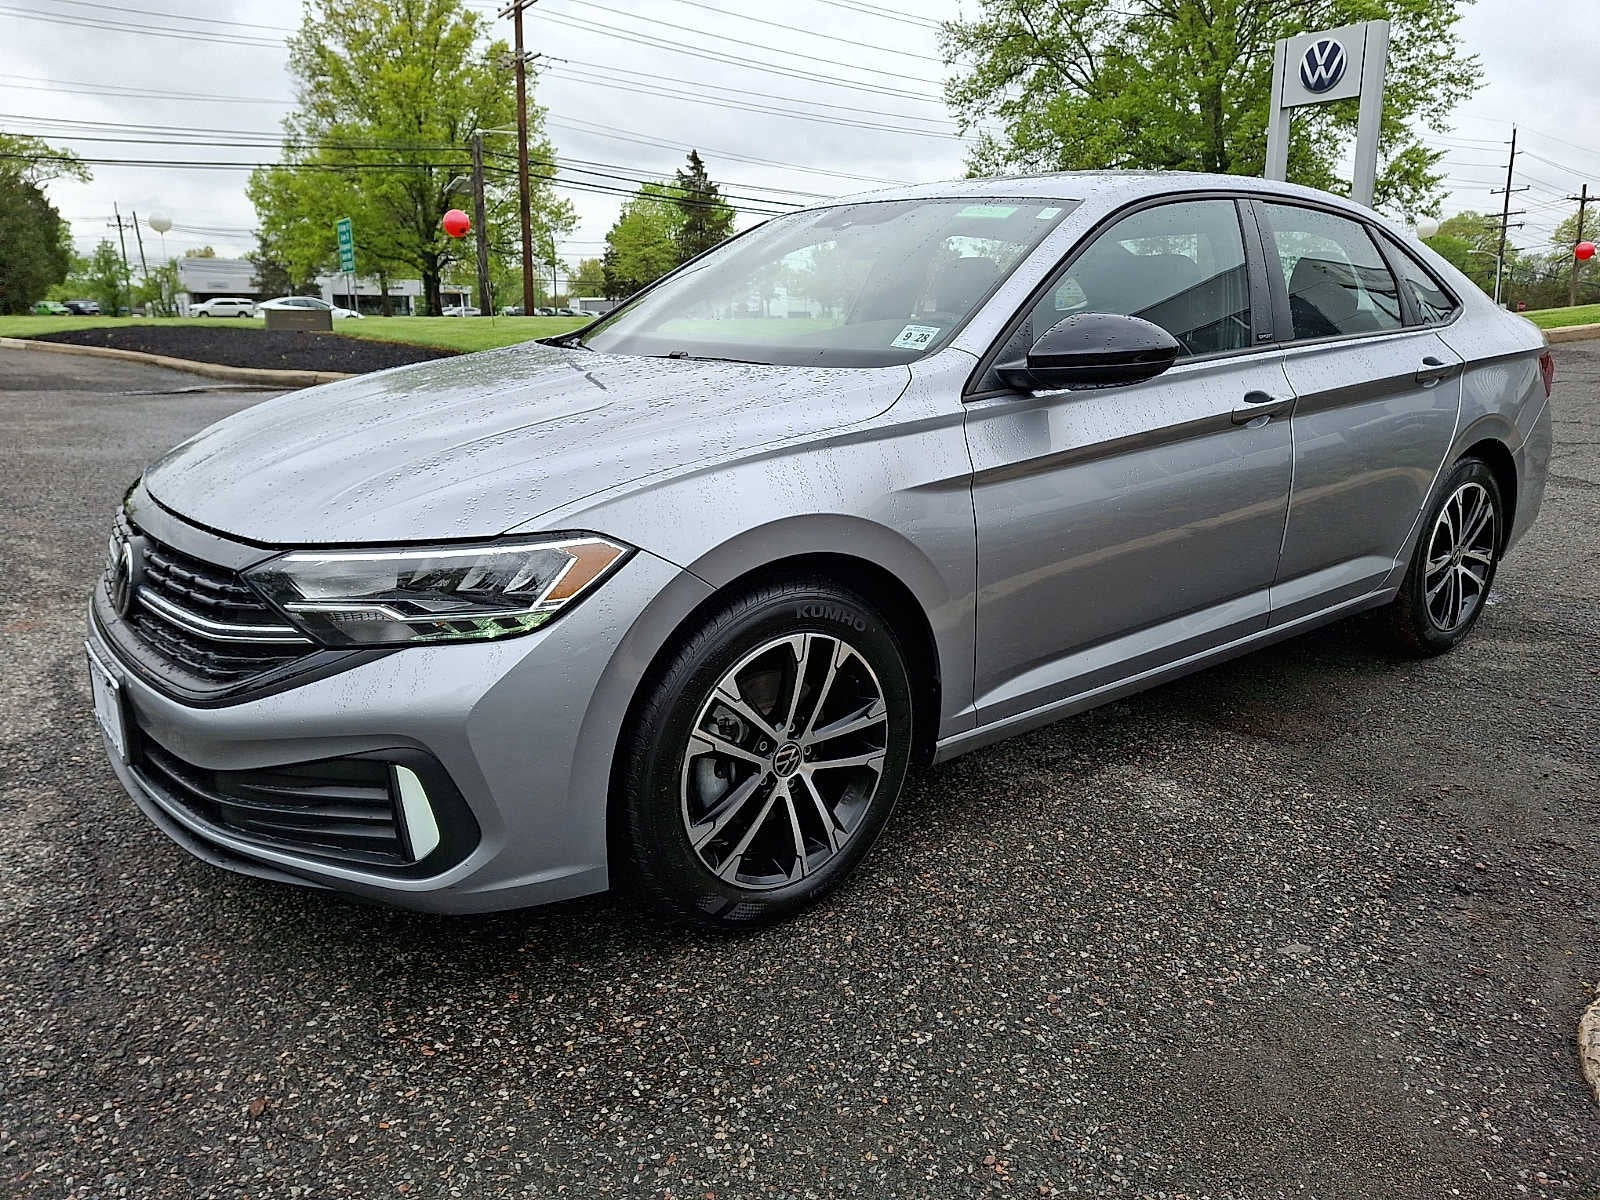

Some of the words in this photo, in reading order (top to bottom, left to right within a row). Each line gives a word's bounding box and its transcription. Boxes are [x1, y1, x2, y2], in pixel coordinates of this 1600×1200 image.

[1300, 39, 1346, 91] VW
[903, 332, 912, 341] 9
[794, 605, 866, 632] KUMHO
